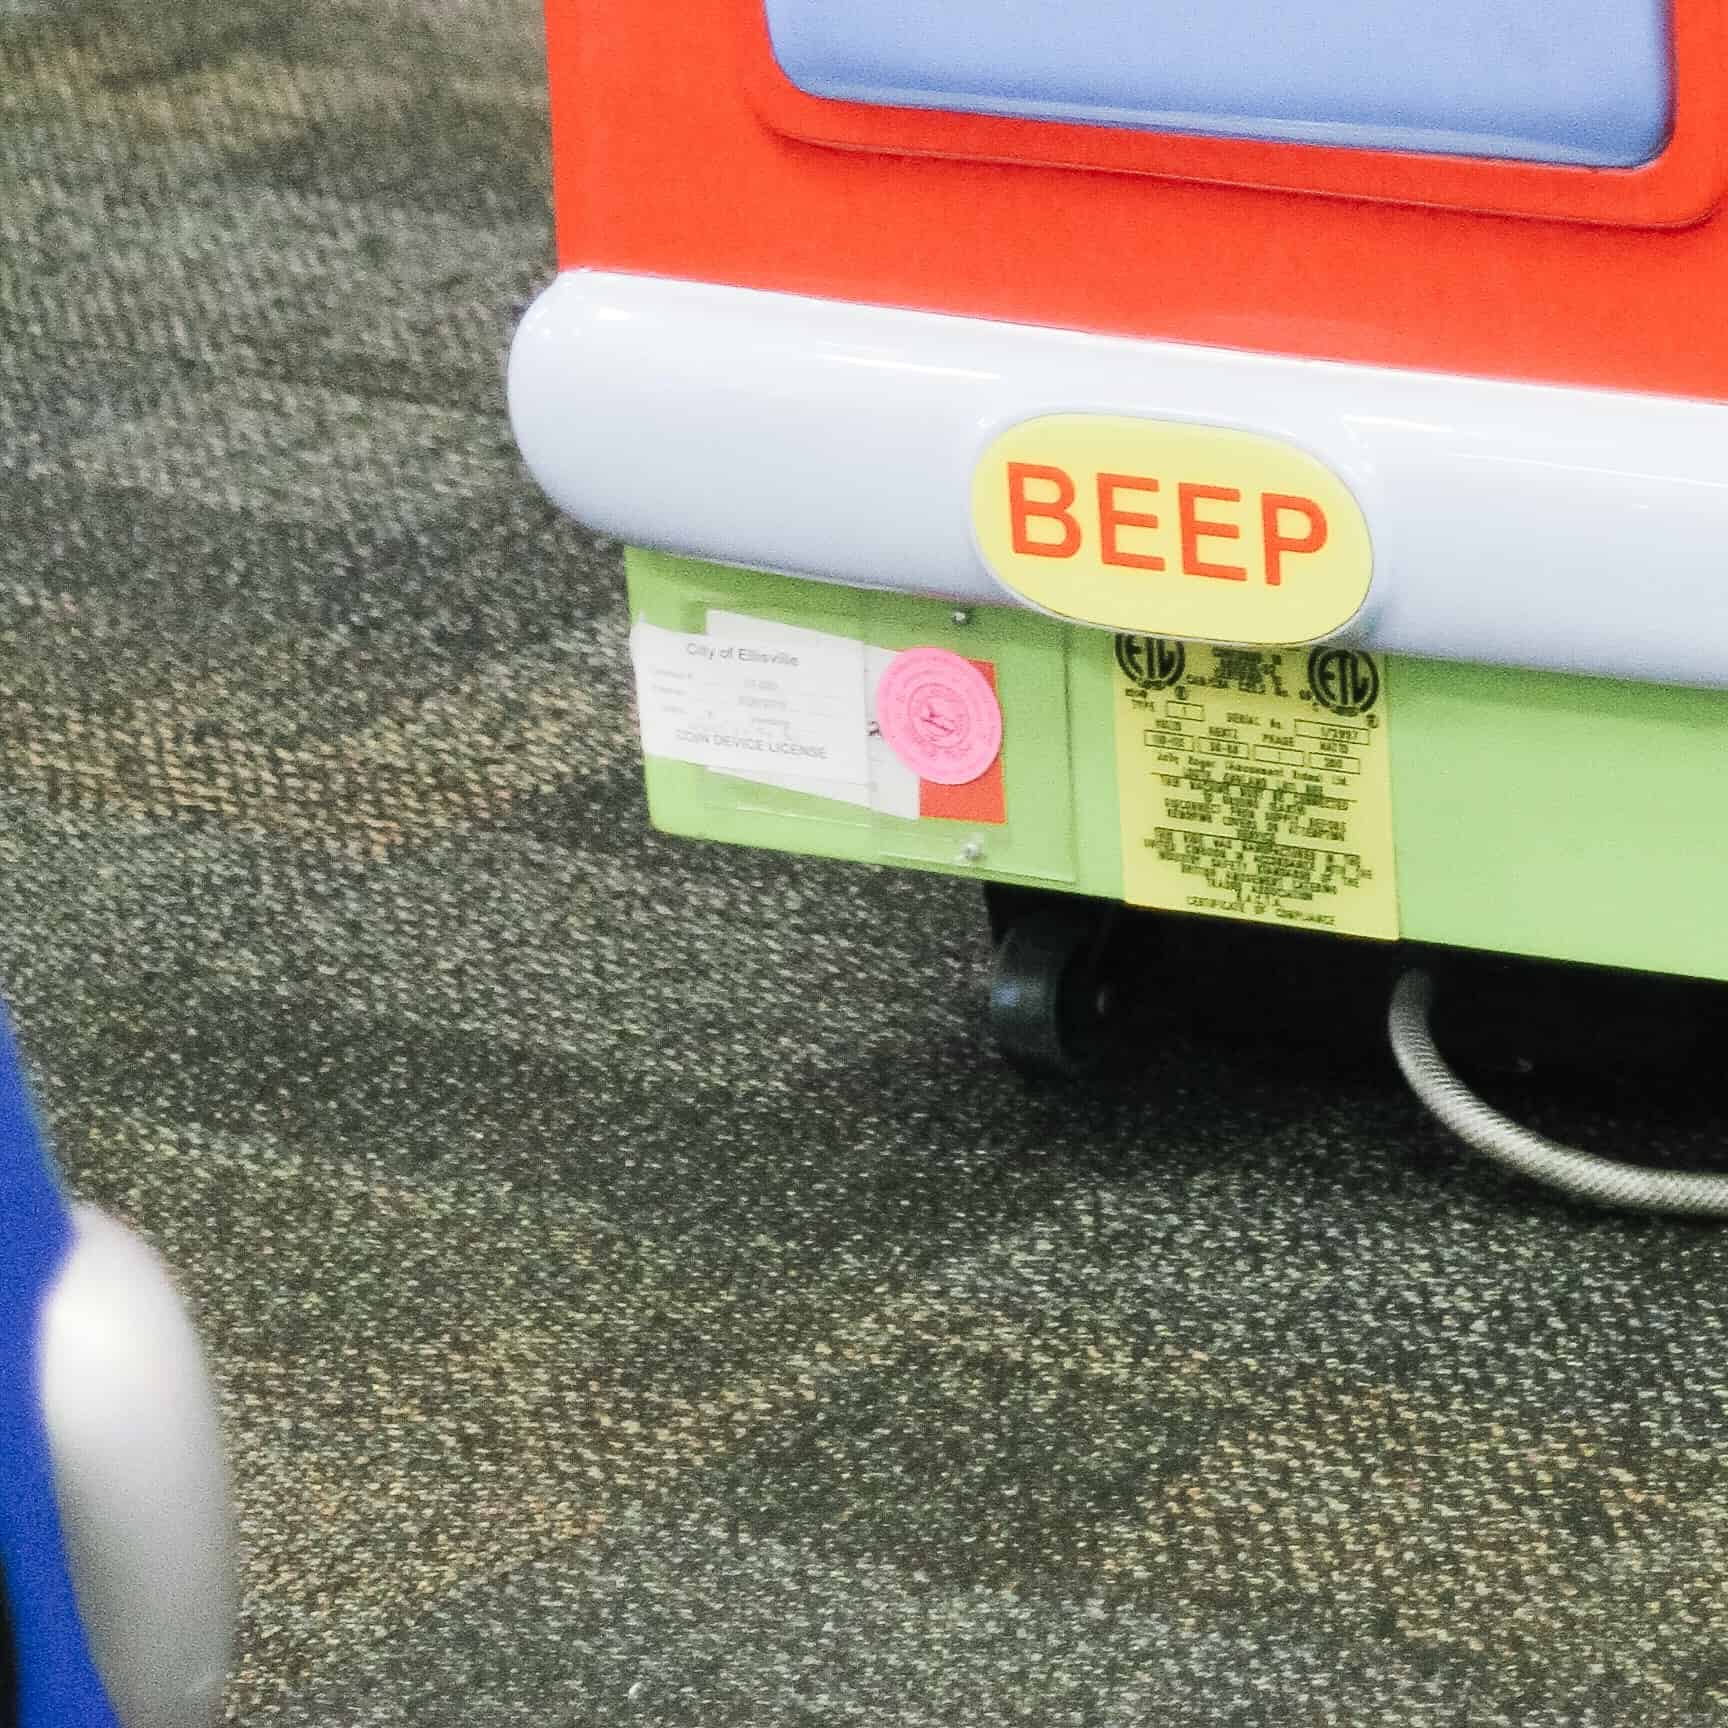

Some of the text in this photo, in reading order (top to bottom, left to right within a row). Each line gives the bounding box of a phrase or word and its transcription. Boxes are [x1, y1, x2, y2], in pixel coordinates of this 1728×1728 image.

[1007, 461, 1328, 586] BEEP
[719, 644, 733, 659] of
[714, 734, 765, 752] DEVICE
[768, 742, 829, 760] LICENSE
